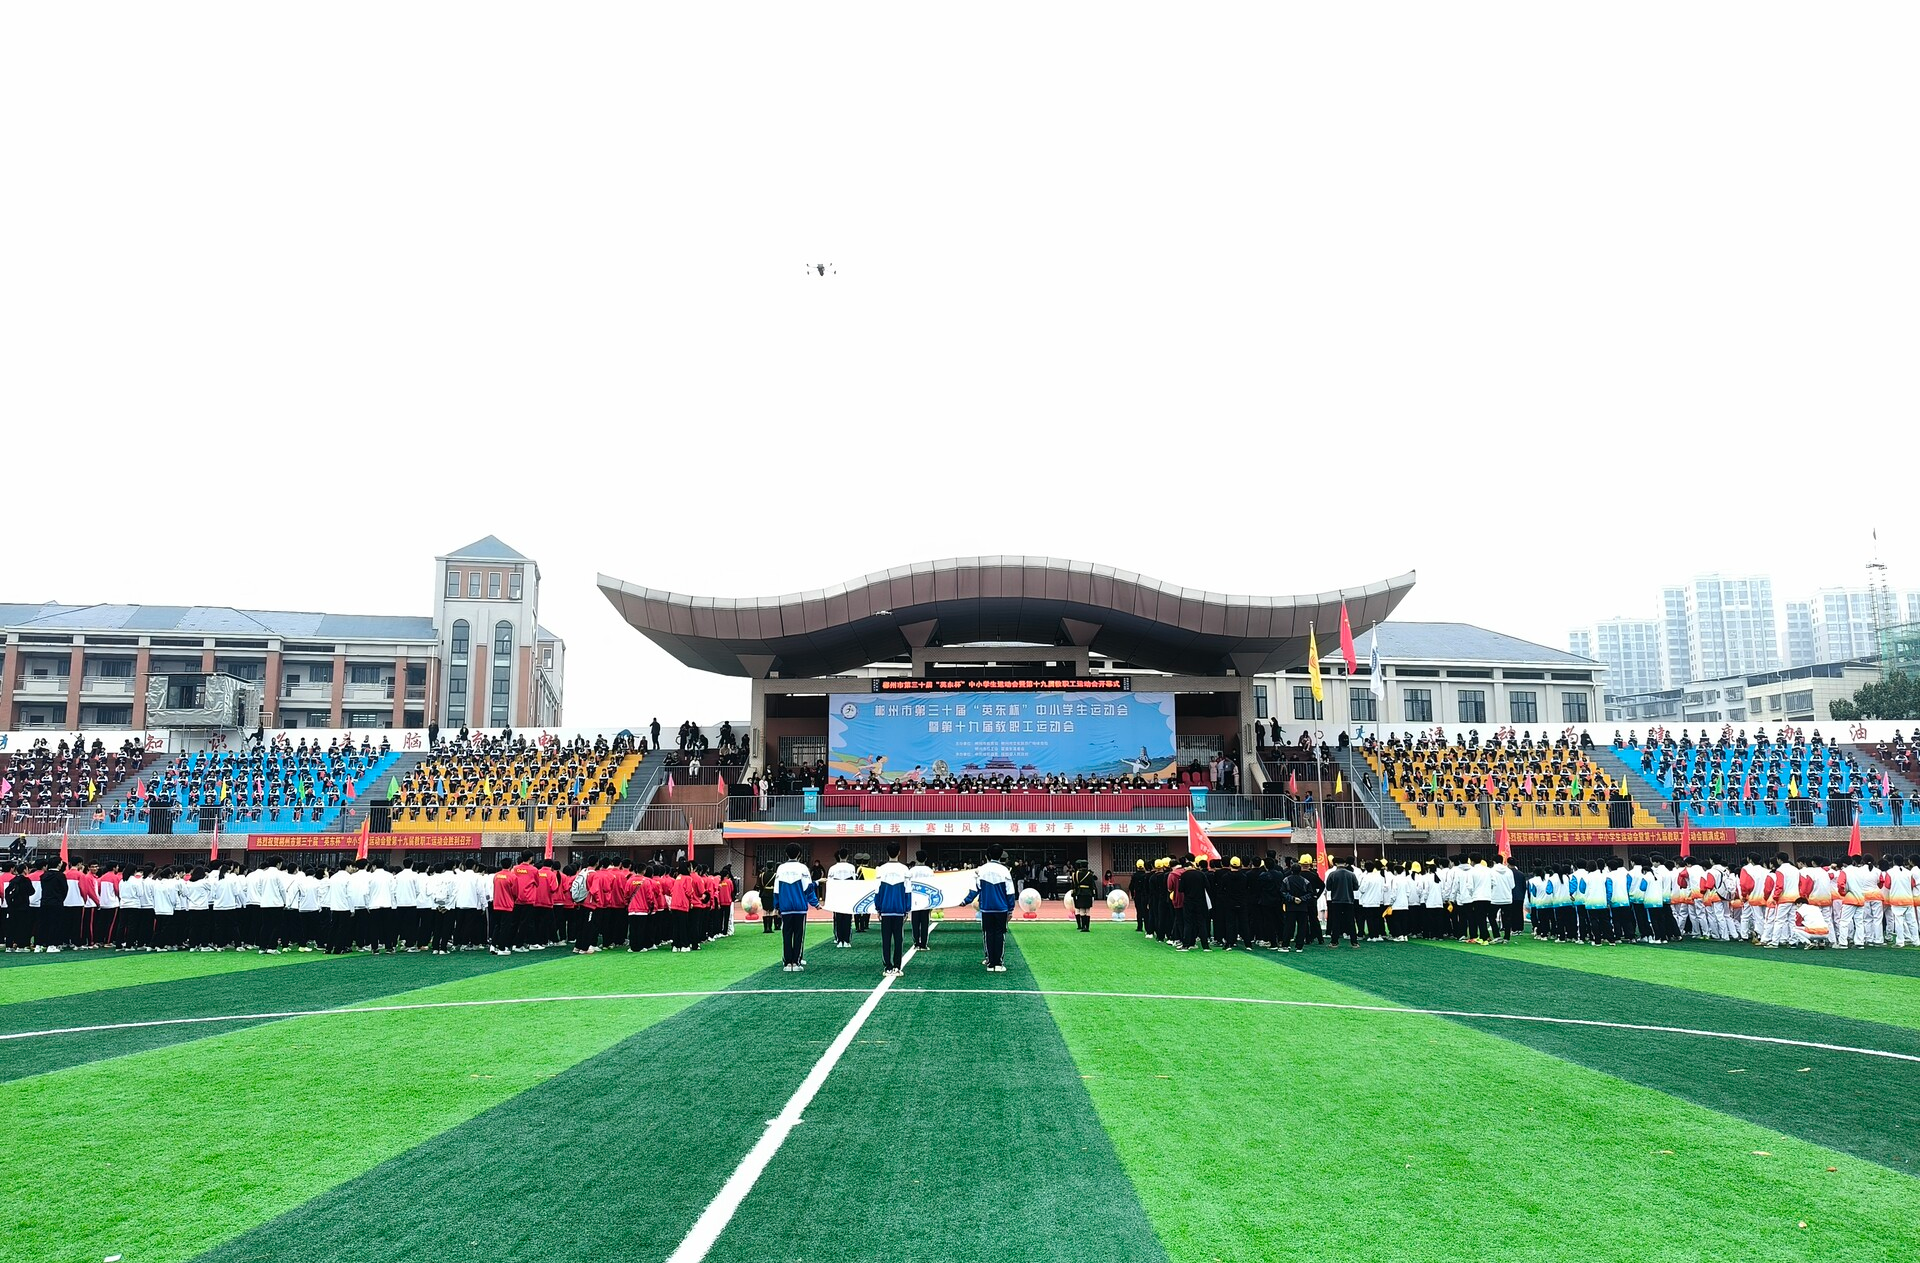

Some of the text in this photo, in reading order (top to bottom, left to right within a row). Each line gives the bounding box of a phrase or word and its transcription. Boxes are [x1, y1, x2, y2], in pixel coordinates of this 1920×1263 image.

[874, 704, 1128, 717] 郴州市第三十届“英东杯”中小学生运动会
[928, 720, 1074, 733] 暨第十九届教职工运动会
